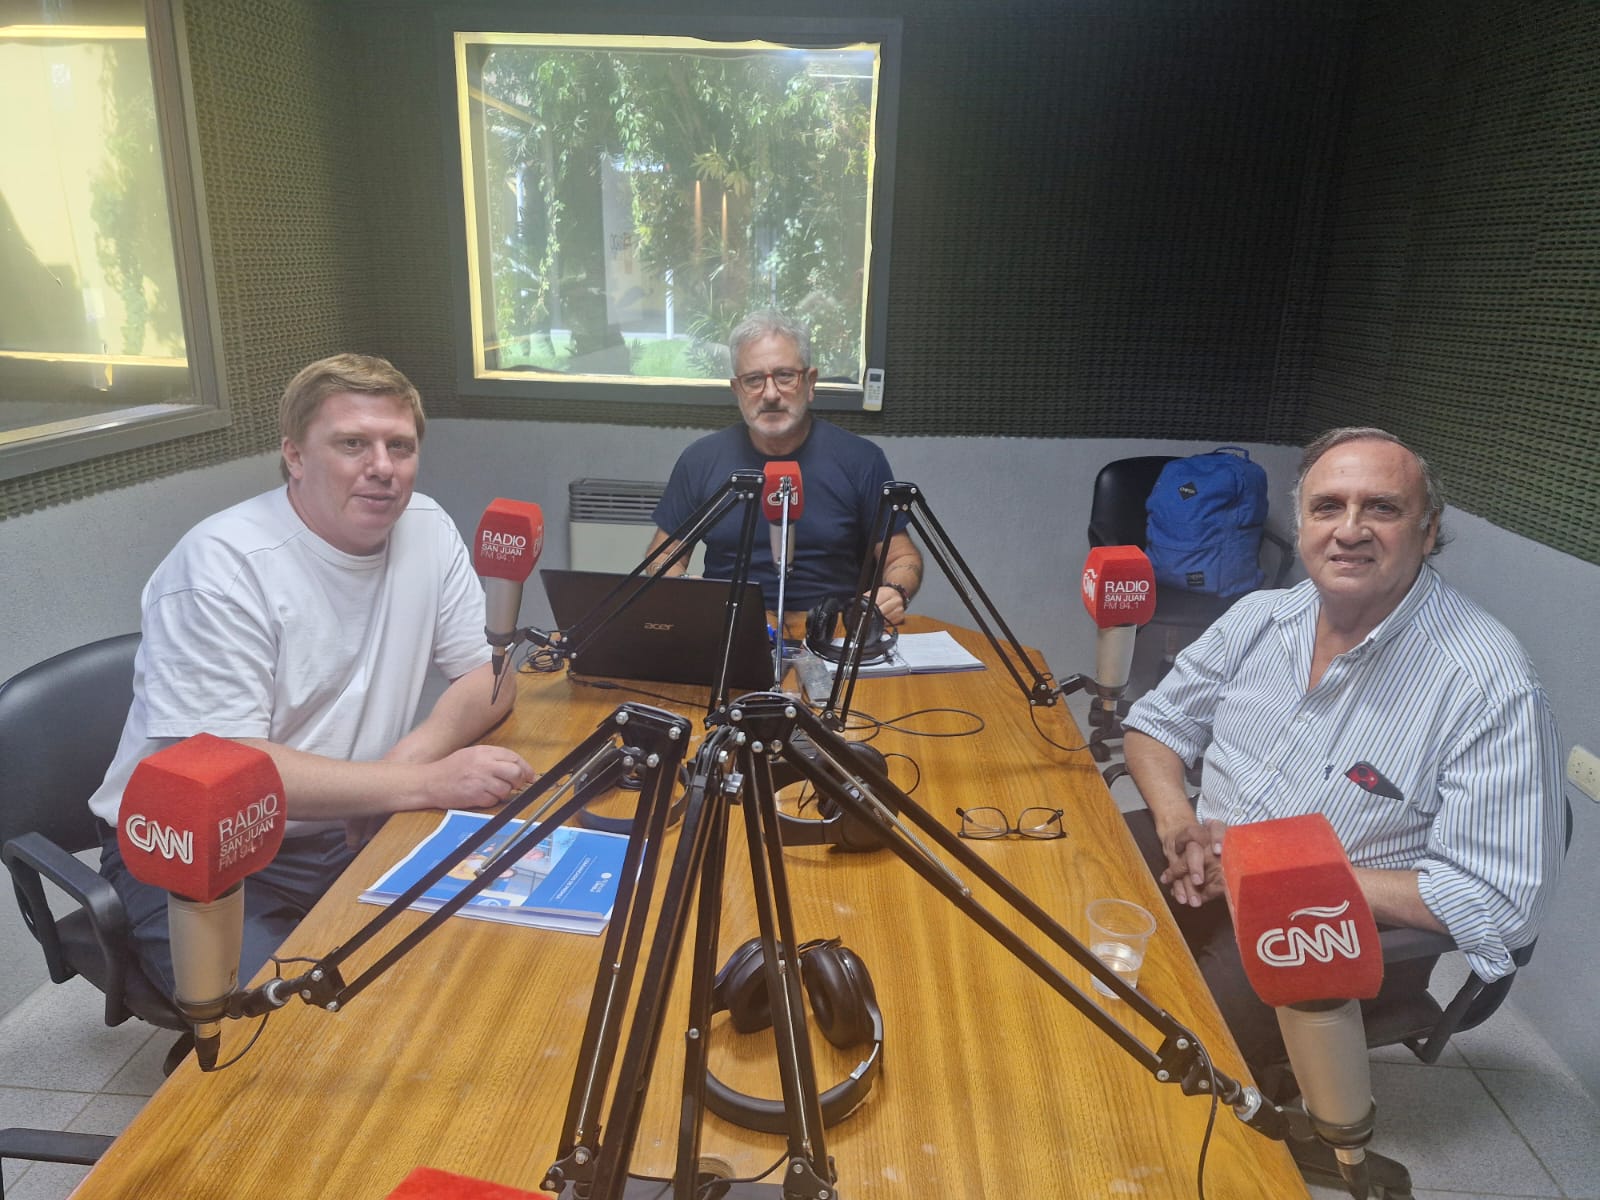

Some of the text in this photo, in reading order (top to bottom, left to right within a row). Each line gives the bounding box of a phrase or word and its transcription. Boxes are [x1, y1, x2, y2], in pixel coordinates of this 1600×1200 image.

[482, 530, 527, 548] RADIO
[480, 550, 494, 560] FM
[481, 543, 522, 556] SAN JUAN
[1104, 580, 1150, 593] RADIO
[1103, 601, 1139, 610] FM 94.1
[1104, 594, 1146, 602] SAN JUAN
[643, 622, 674, 631] acer
[219, 793, 278, 842] RADIO
[125, 814, 193, 865] CNN
[220, 817, 274, 857] SAN JUAN
[218, 850, 237, 872] FM
[1256, 916, 1361, 967] CNN
